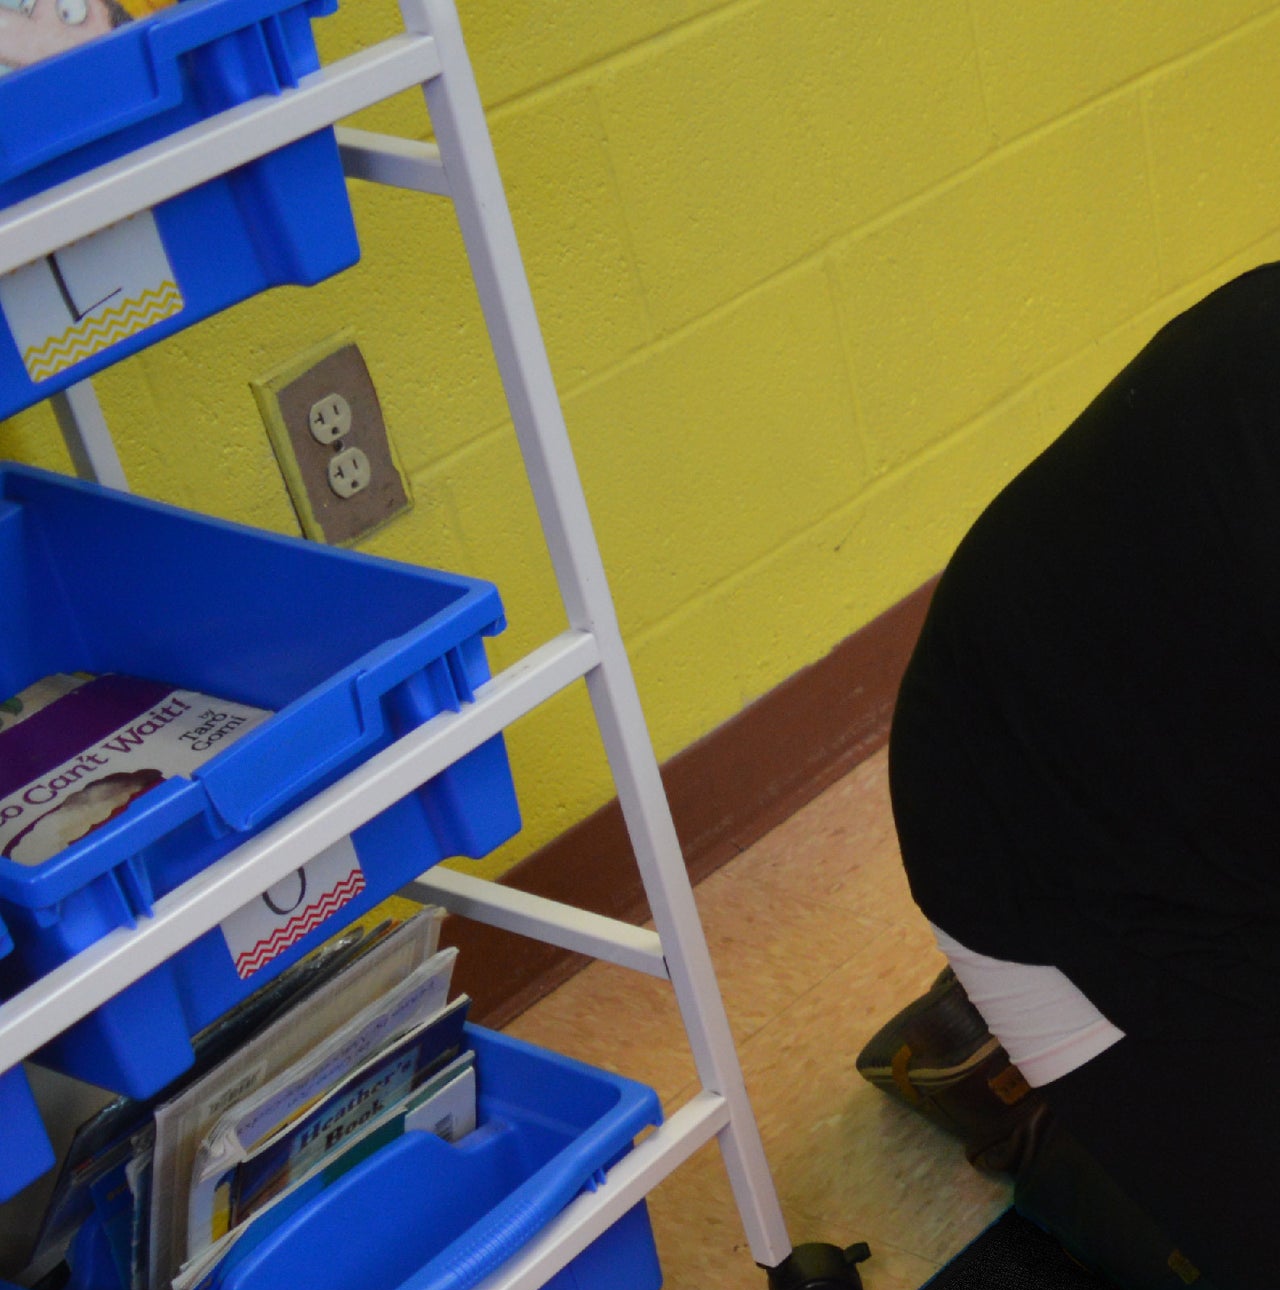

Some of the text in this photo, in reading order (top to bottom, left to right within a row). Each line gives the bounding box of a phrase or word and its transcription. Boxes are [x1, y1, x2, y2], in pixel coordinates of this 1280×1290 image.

[178, 712, 228, 741] Taro
[191, 714, 247, 751] Gomi
[197, 708, 215, 720] by
[23, 752, 110, 806] Can't
[103, 697, 193, 755] Wait!
[299, 1058, 413, 1152] Heather's
[324, 1099, 385, 1152] Book
